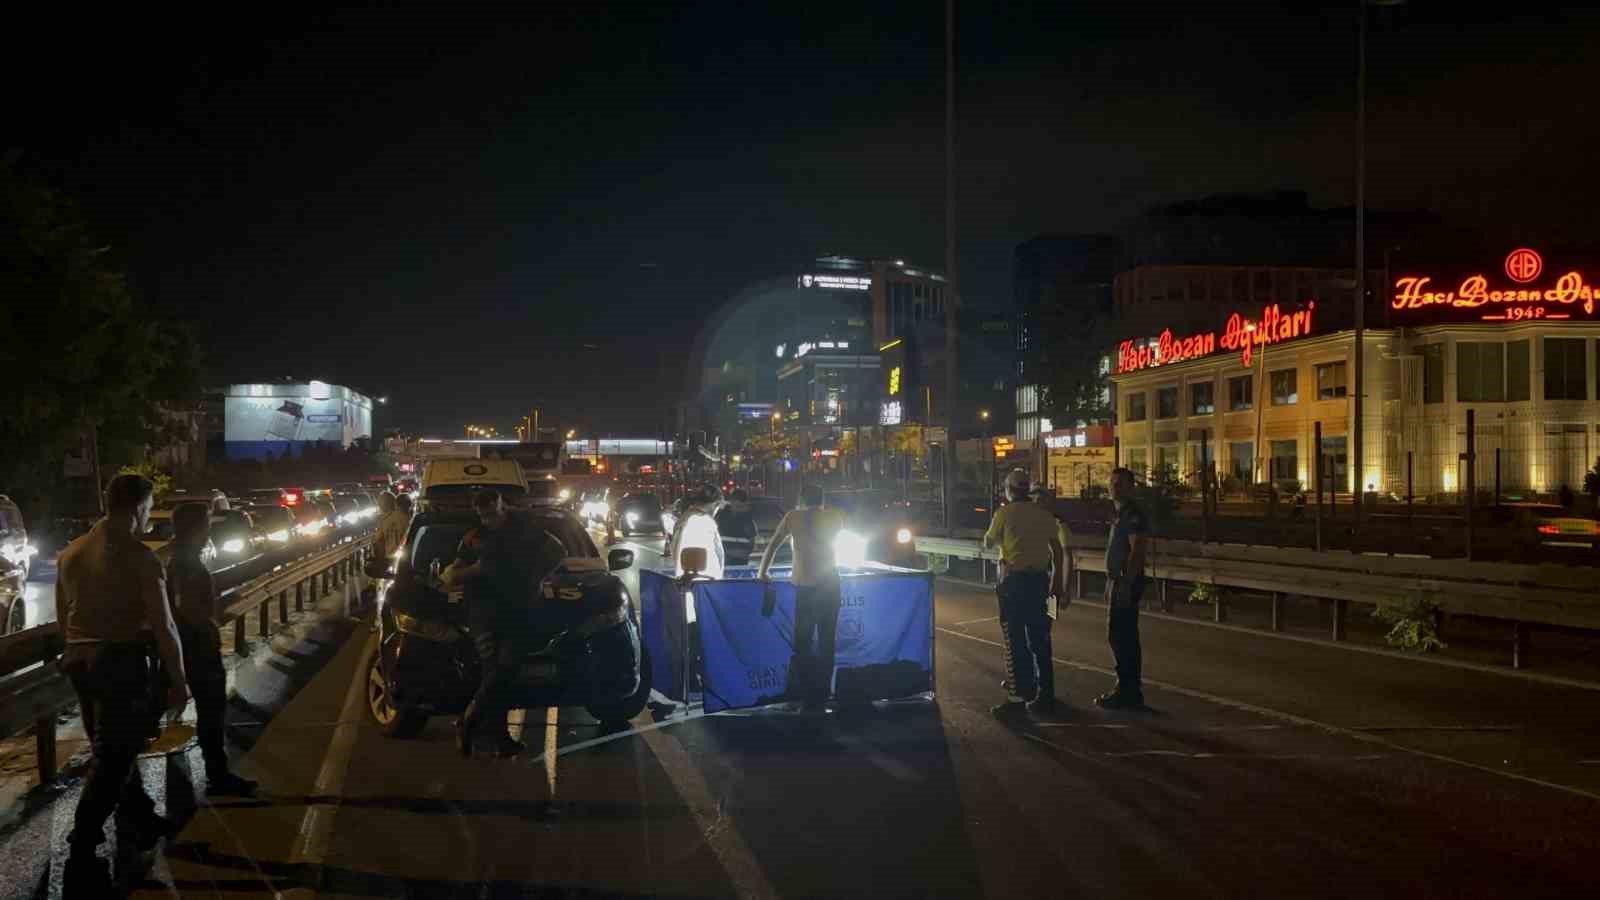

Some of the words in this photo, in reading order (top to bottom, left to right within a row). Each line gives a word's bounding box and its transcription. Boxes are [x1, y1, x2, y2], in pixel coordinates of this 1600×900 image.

[1392, 277, 1454, 310] Hacı
[1454, 274, 1541, 308] Bozan
[1158, 328, 1216, 363] Bozan
